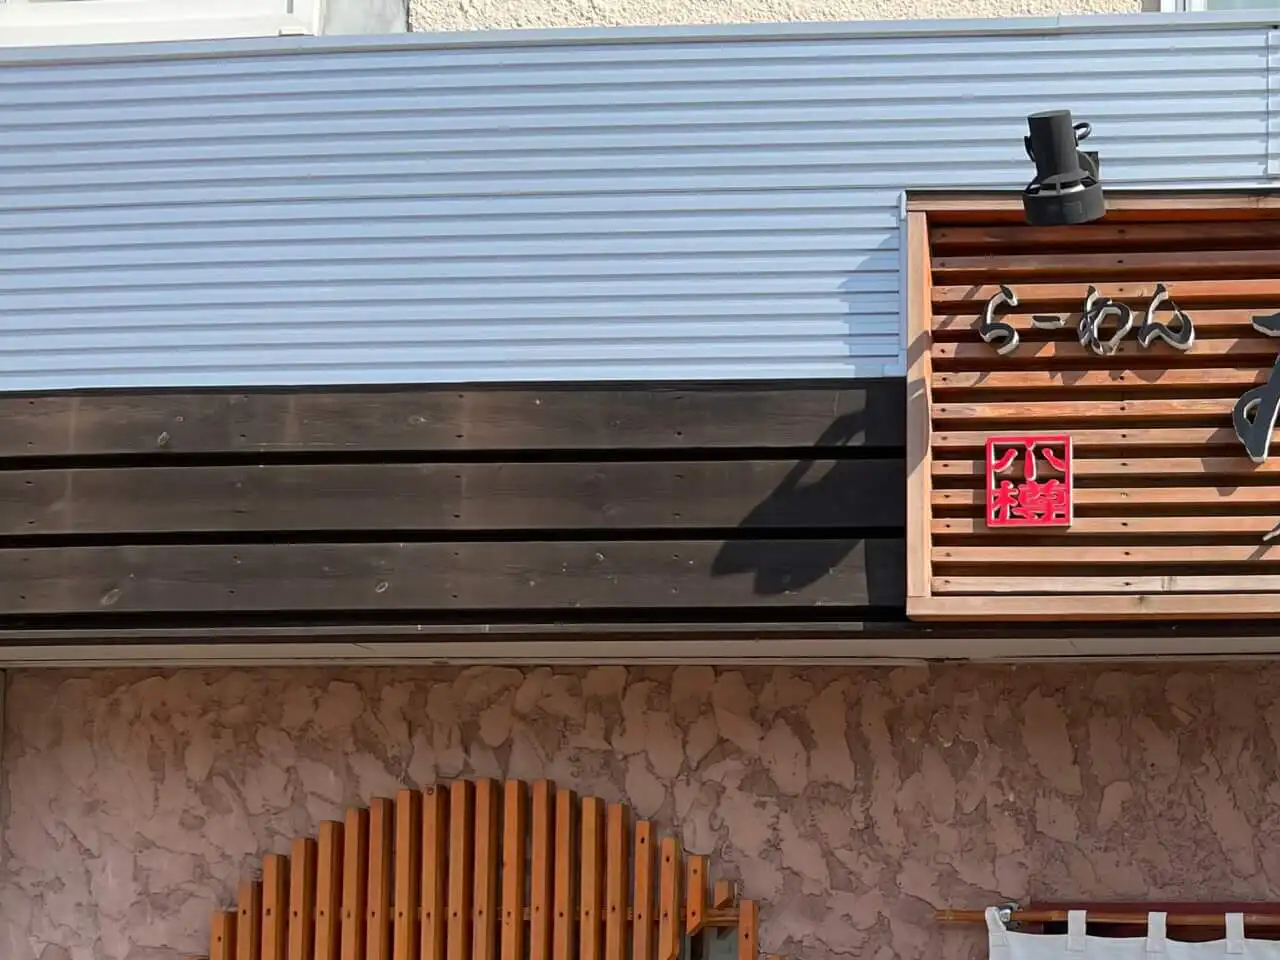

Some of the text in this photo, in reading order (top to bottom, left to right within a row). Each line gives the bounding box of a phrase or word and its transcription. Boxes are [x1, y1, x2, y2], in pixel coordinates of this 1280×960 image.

[979, 283, 1195, 355] らーめん
[985, 434, 1072, 527] 小樽
